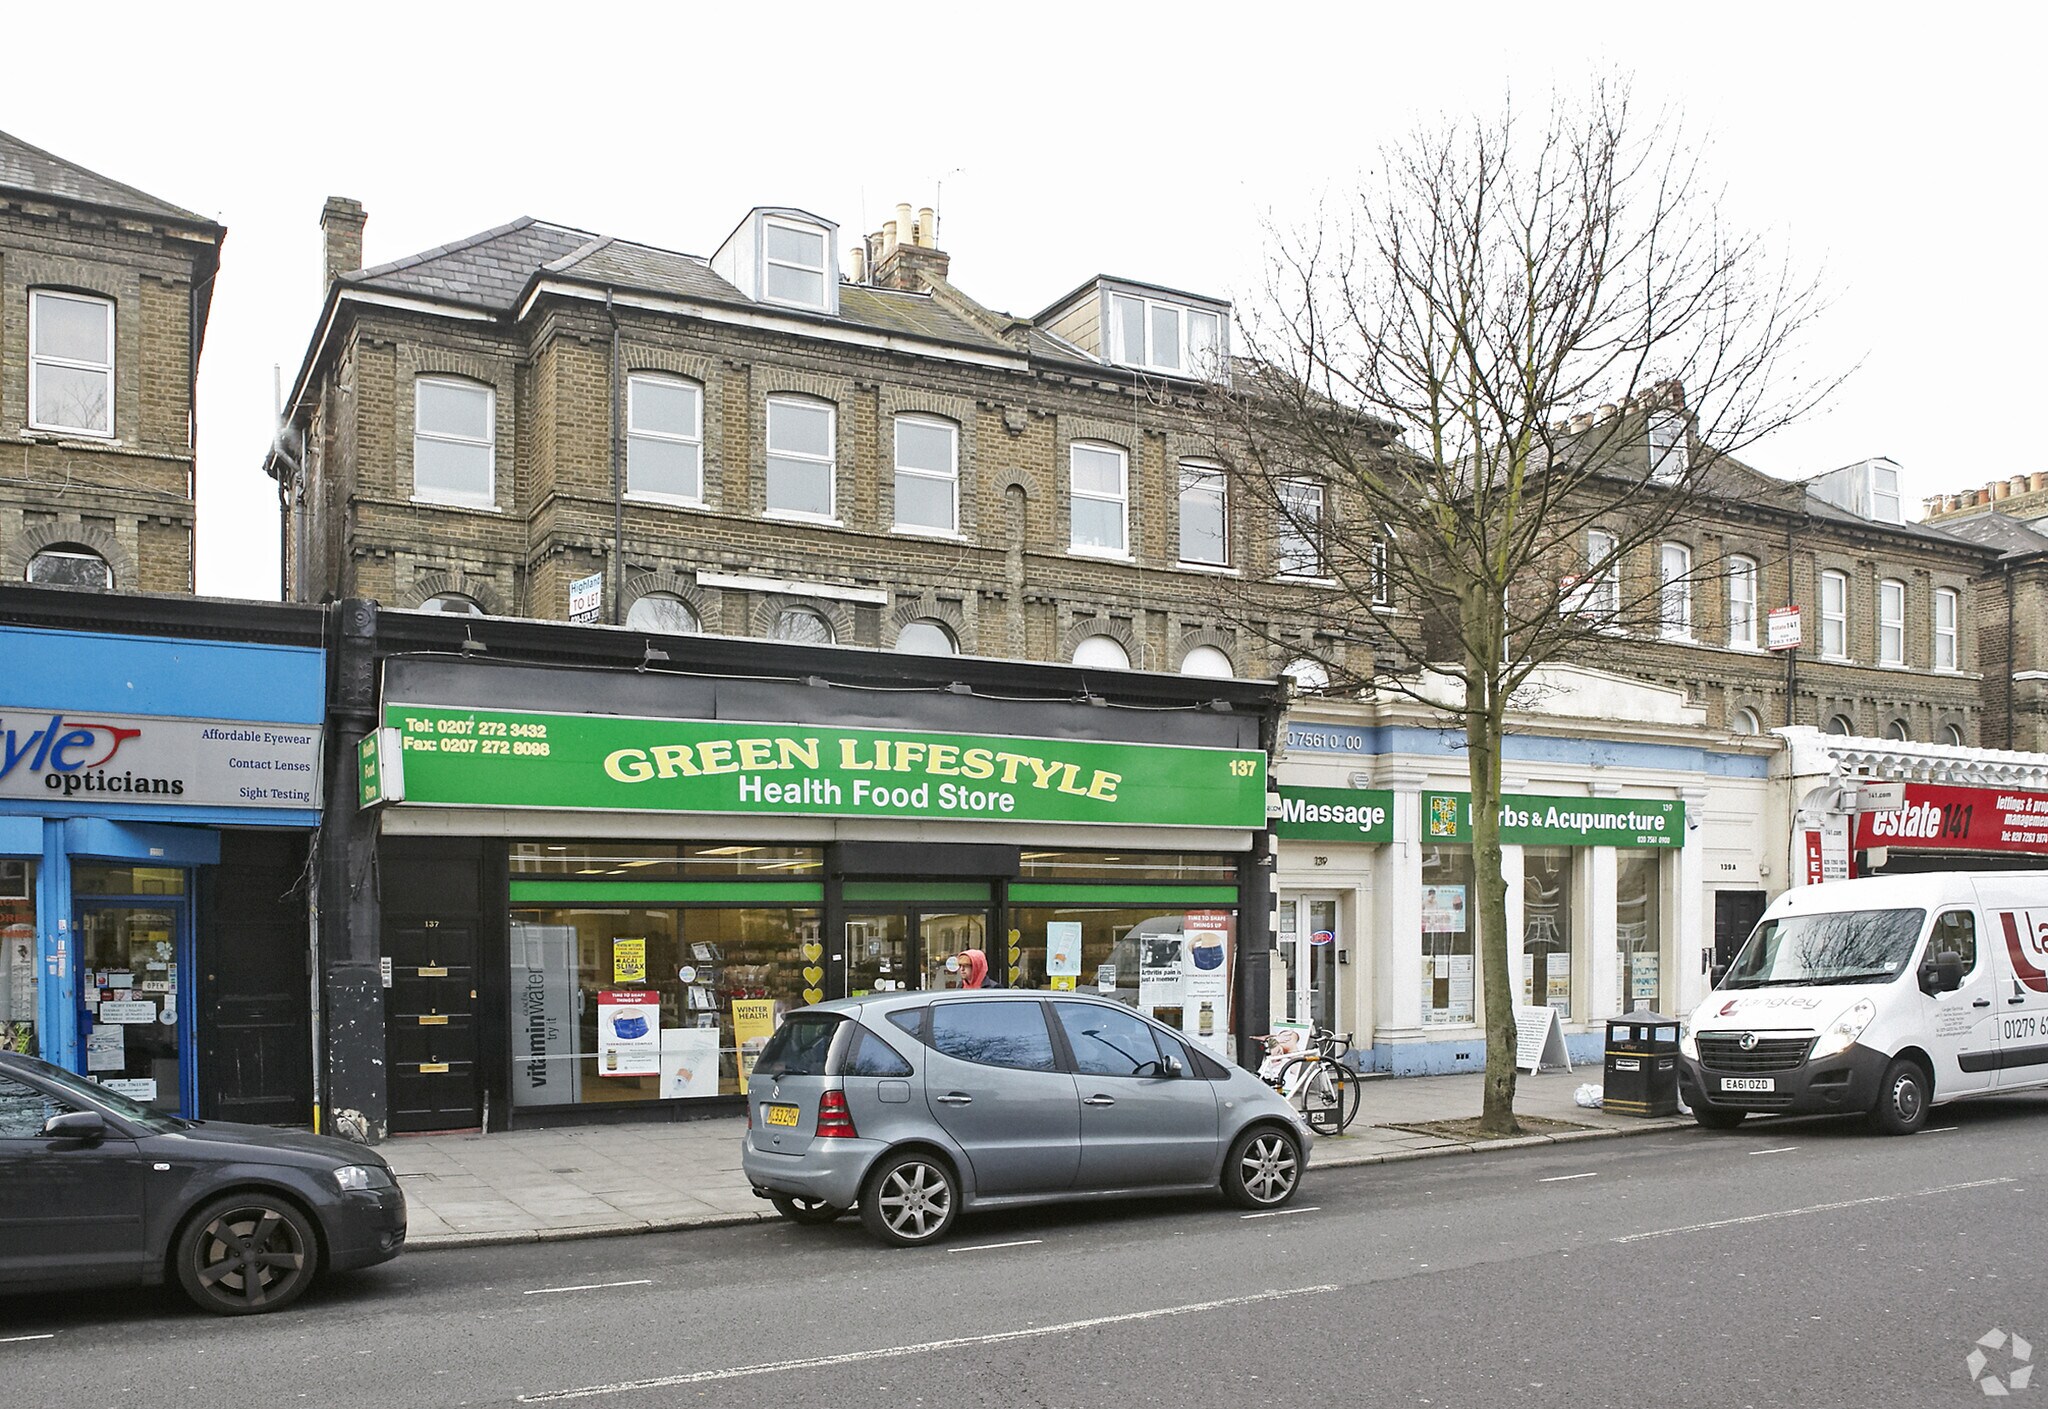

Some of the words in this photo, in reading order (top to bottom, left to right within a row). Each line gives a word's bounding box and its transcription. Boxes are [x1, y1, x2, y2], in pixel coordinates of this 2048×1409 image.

[571, 575, 600, 595] Highland
[573, 597, 585, 611] TO
[587, 592, 599, 608] LET
[202, 728, 260, 742] Affordable
[263, 732, 311, 747] Eyewear
[405, 718, 434, 733] Tel:
[437, 719, 475, 737] 0207
[478, 722, 507, 737] 272
[510, 725, 548, 740] 3432
[0, 716, 95, 782] yle
[403, 736, 438, 752] Fax:
[440, 738, 479, 753] 0207
[482, 740, 511, 755] 272
[229, 757, 272, 772] Contact
[274, 760, 311, 773] Lenses
[604, 738, 819, 783] GREEN
[839, 739, 1122, 802] LIFESTYLE
[1229, 759, 1257, 777] 137
[45, 769, 184, 796] opticians
[240, 787, 267, 801] Sight
[270, 789, 310, 803] Testing
[738, 774, 843, 806] Health
[852, 780, 929, 809] Food
[938, 783, 1016, 813] Store
[1662, 804, 1673, 812] 139
[1996, 794, 2026, 813] lettings
[2025, 797, 2033, 812] &
[1282, 798, 1386, 833] Massage
[1468, 803, 1528, 828] rbs
[1532, 813, 1543, 826] &
[1544, 805, 1666, 835] Acupuncture
[1314, 856, 1328, 866] 139
[424, 920, 440, 928] 137
[430, 959, 436, 967] A
[1163, 970, 1177, 978] pain
[736, 1006, 767, 1014] WINTER
[738, 1012, 768, 1020] HEALTH
[527, 967, 547, 1089] vitaminwater
[547, 1017, 557, 1026] it
[2004, 1017, 2036, 1040] 01279
[547, 1027, 560, 1041] try
[1726, 1080, 1747, 1090] EA61
[1748, 1079, 1768, 1090] OZD
